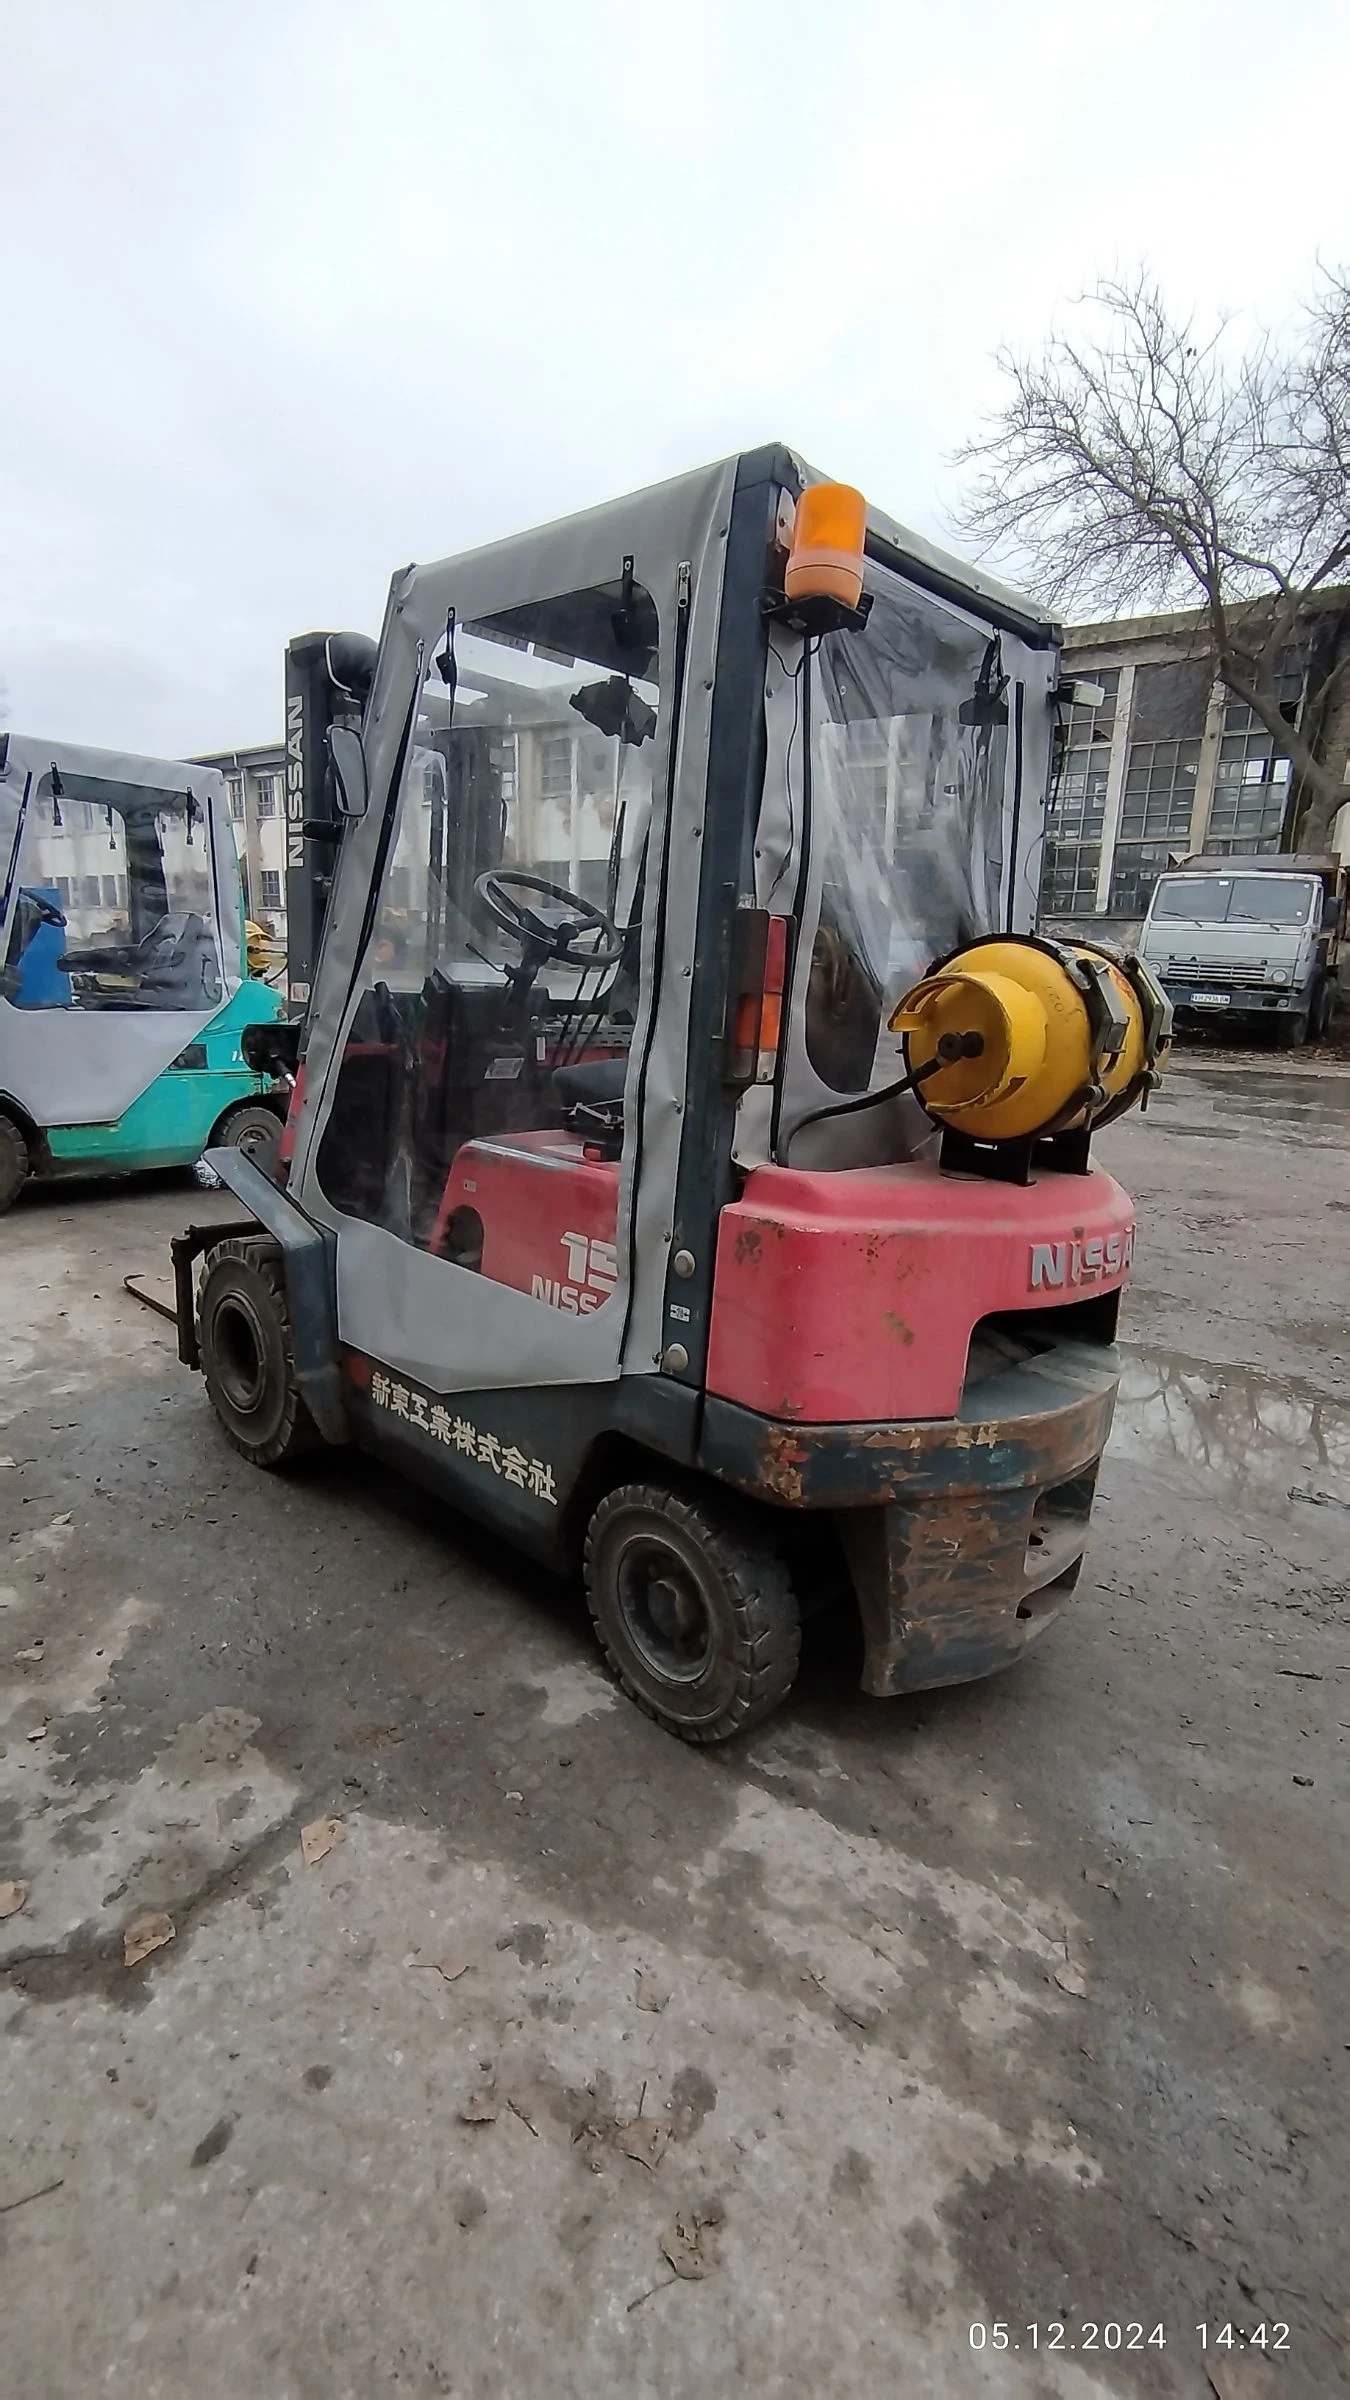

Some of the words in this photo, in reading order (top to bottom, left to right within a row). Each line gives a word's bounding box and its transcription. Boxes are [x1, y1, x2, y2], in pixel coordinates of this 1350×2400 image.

[287, 695, 304, 867] NISSAN
[1030, 1222, 1137, 1287] NISSA
[371, 1371, 558, 1506] 新東工業株式会社
